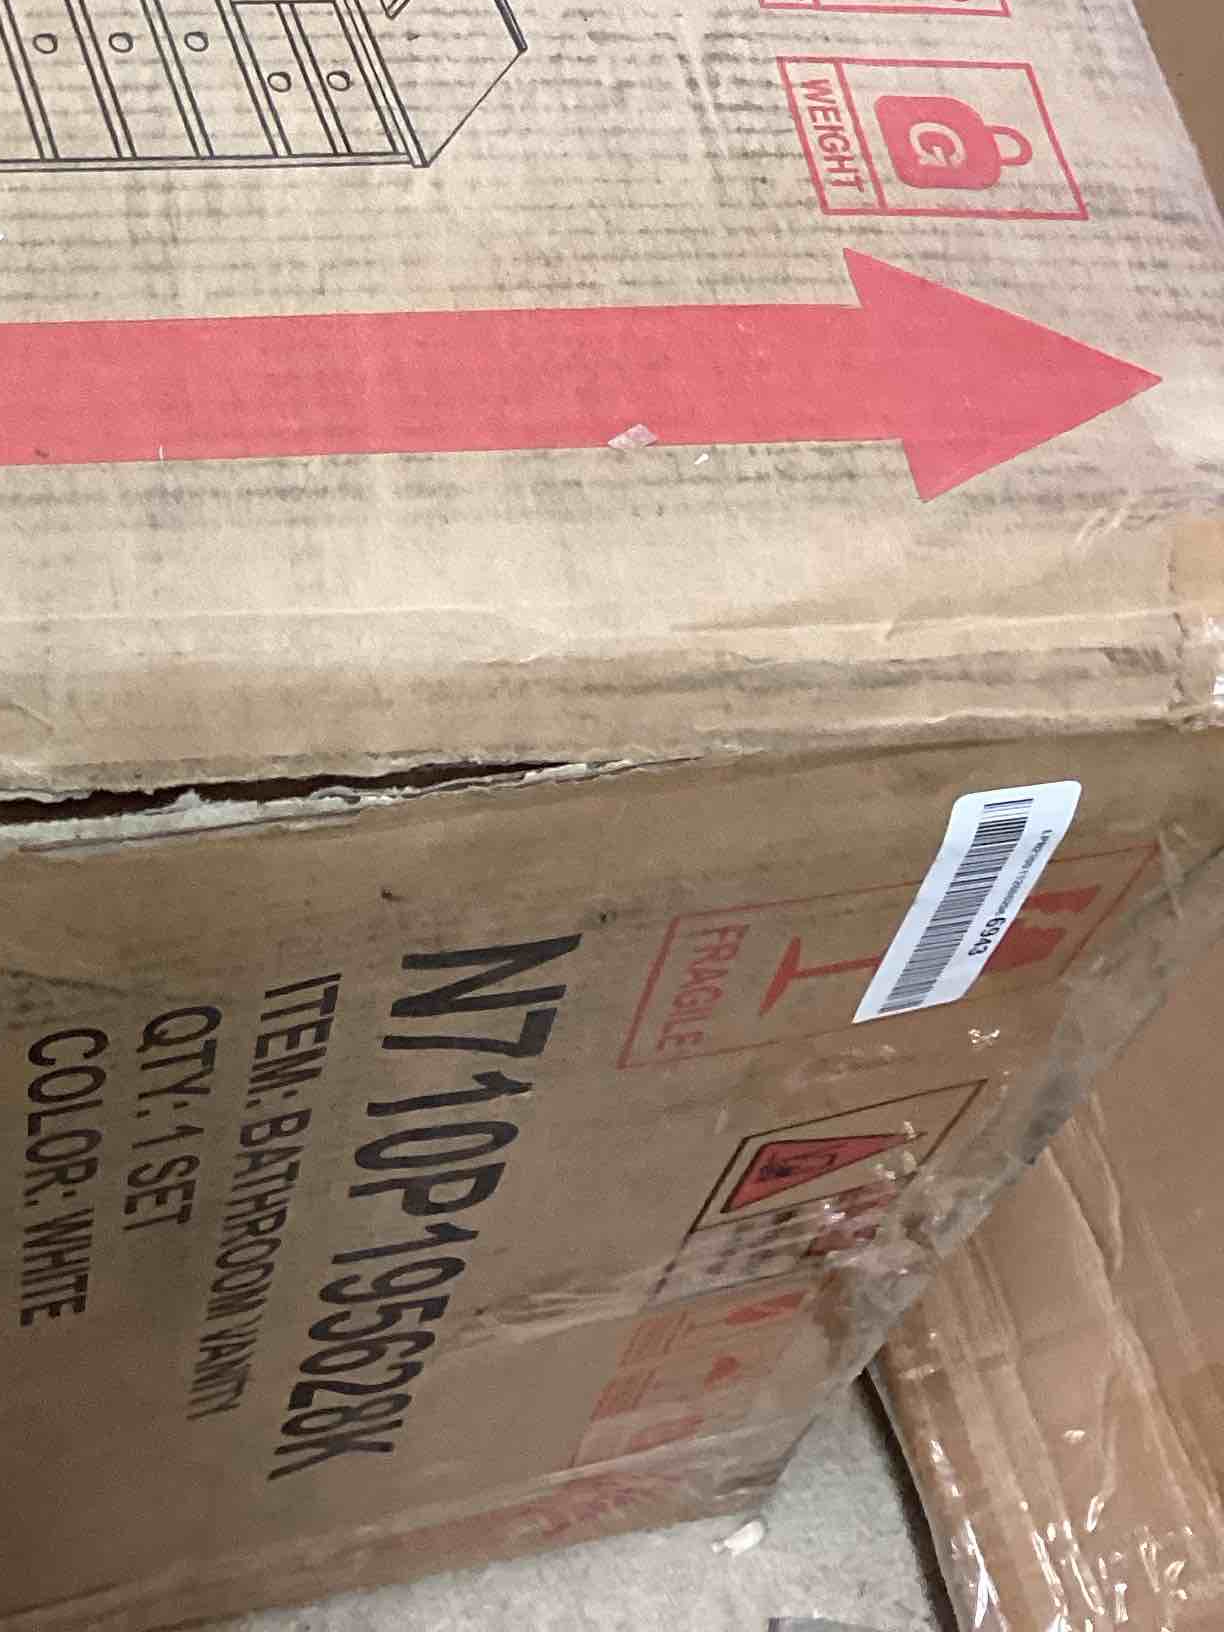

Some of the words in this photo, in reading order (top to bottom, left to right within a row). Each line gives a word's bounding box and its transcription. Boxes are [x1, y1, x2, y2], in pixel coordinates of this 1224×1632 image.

[801, 77, 864, 194] WEIGHT
[246, 972, 343, 1109] ITEM:
[656, 922, 749, 1052] FRAGILE
[23, 1027, 110, 1207] COLOR:
[136, 1005, 223, 1119] QTY:
[123, 1154, 201, 1231] SET
[206, 1108, 313, 1320] BATHROOM
[267, 933, 582, 1480] N710P195628K
[20, 1207, 95, 1327] WHITE
